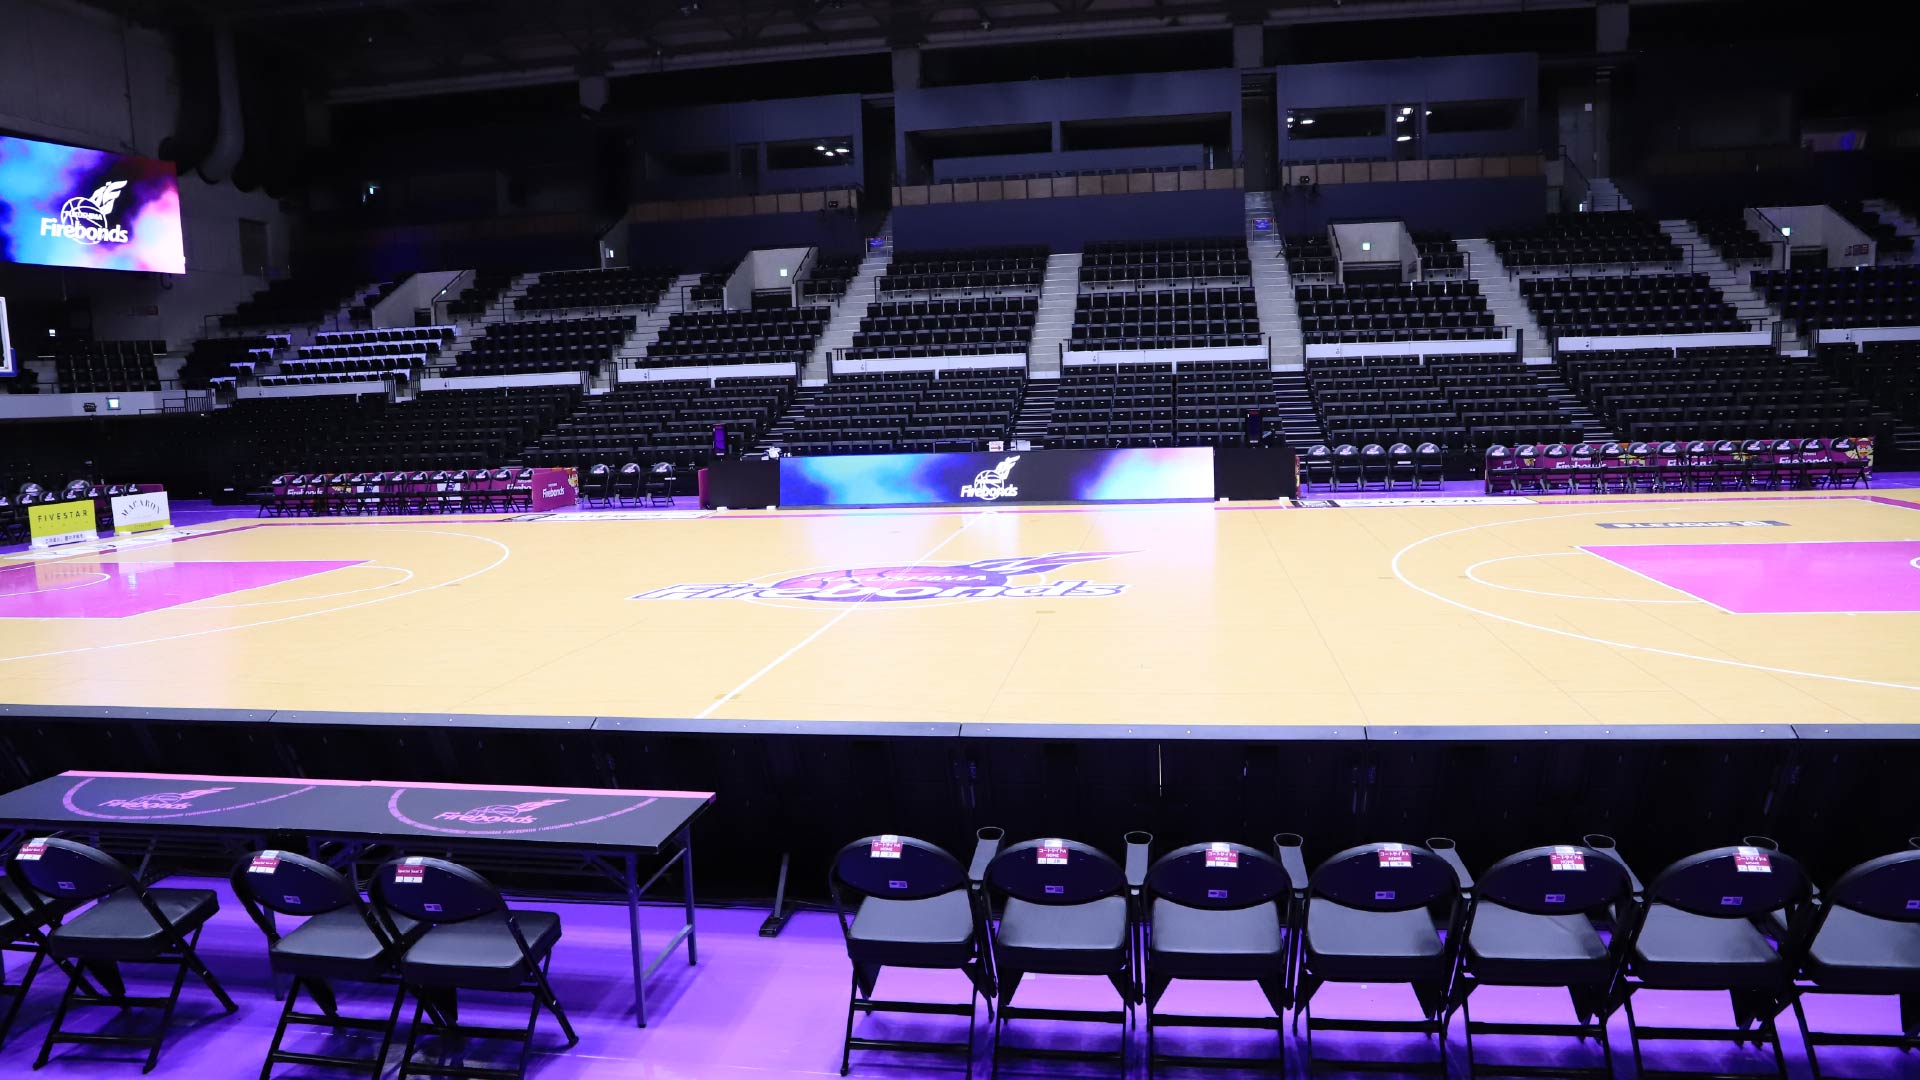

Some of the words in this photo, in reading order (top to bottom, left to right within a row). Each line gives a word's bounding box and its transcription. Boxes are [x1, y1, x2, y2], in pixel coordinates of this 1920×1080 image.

[40, 217, 129, 243] Firebonds
[960, 483, 1019, 498] Firebonds
[37, 508, 89, 523] FIVESTAR
[627, 579, 1130, 601] Firebonds
[97, 798, 193, 811] Firebonds
[432, 810, 539, 825] Firebonds
